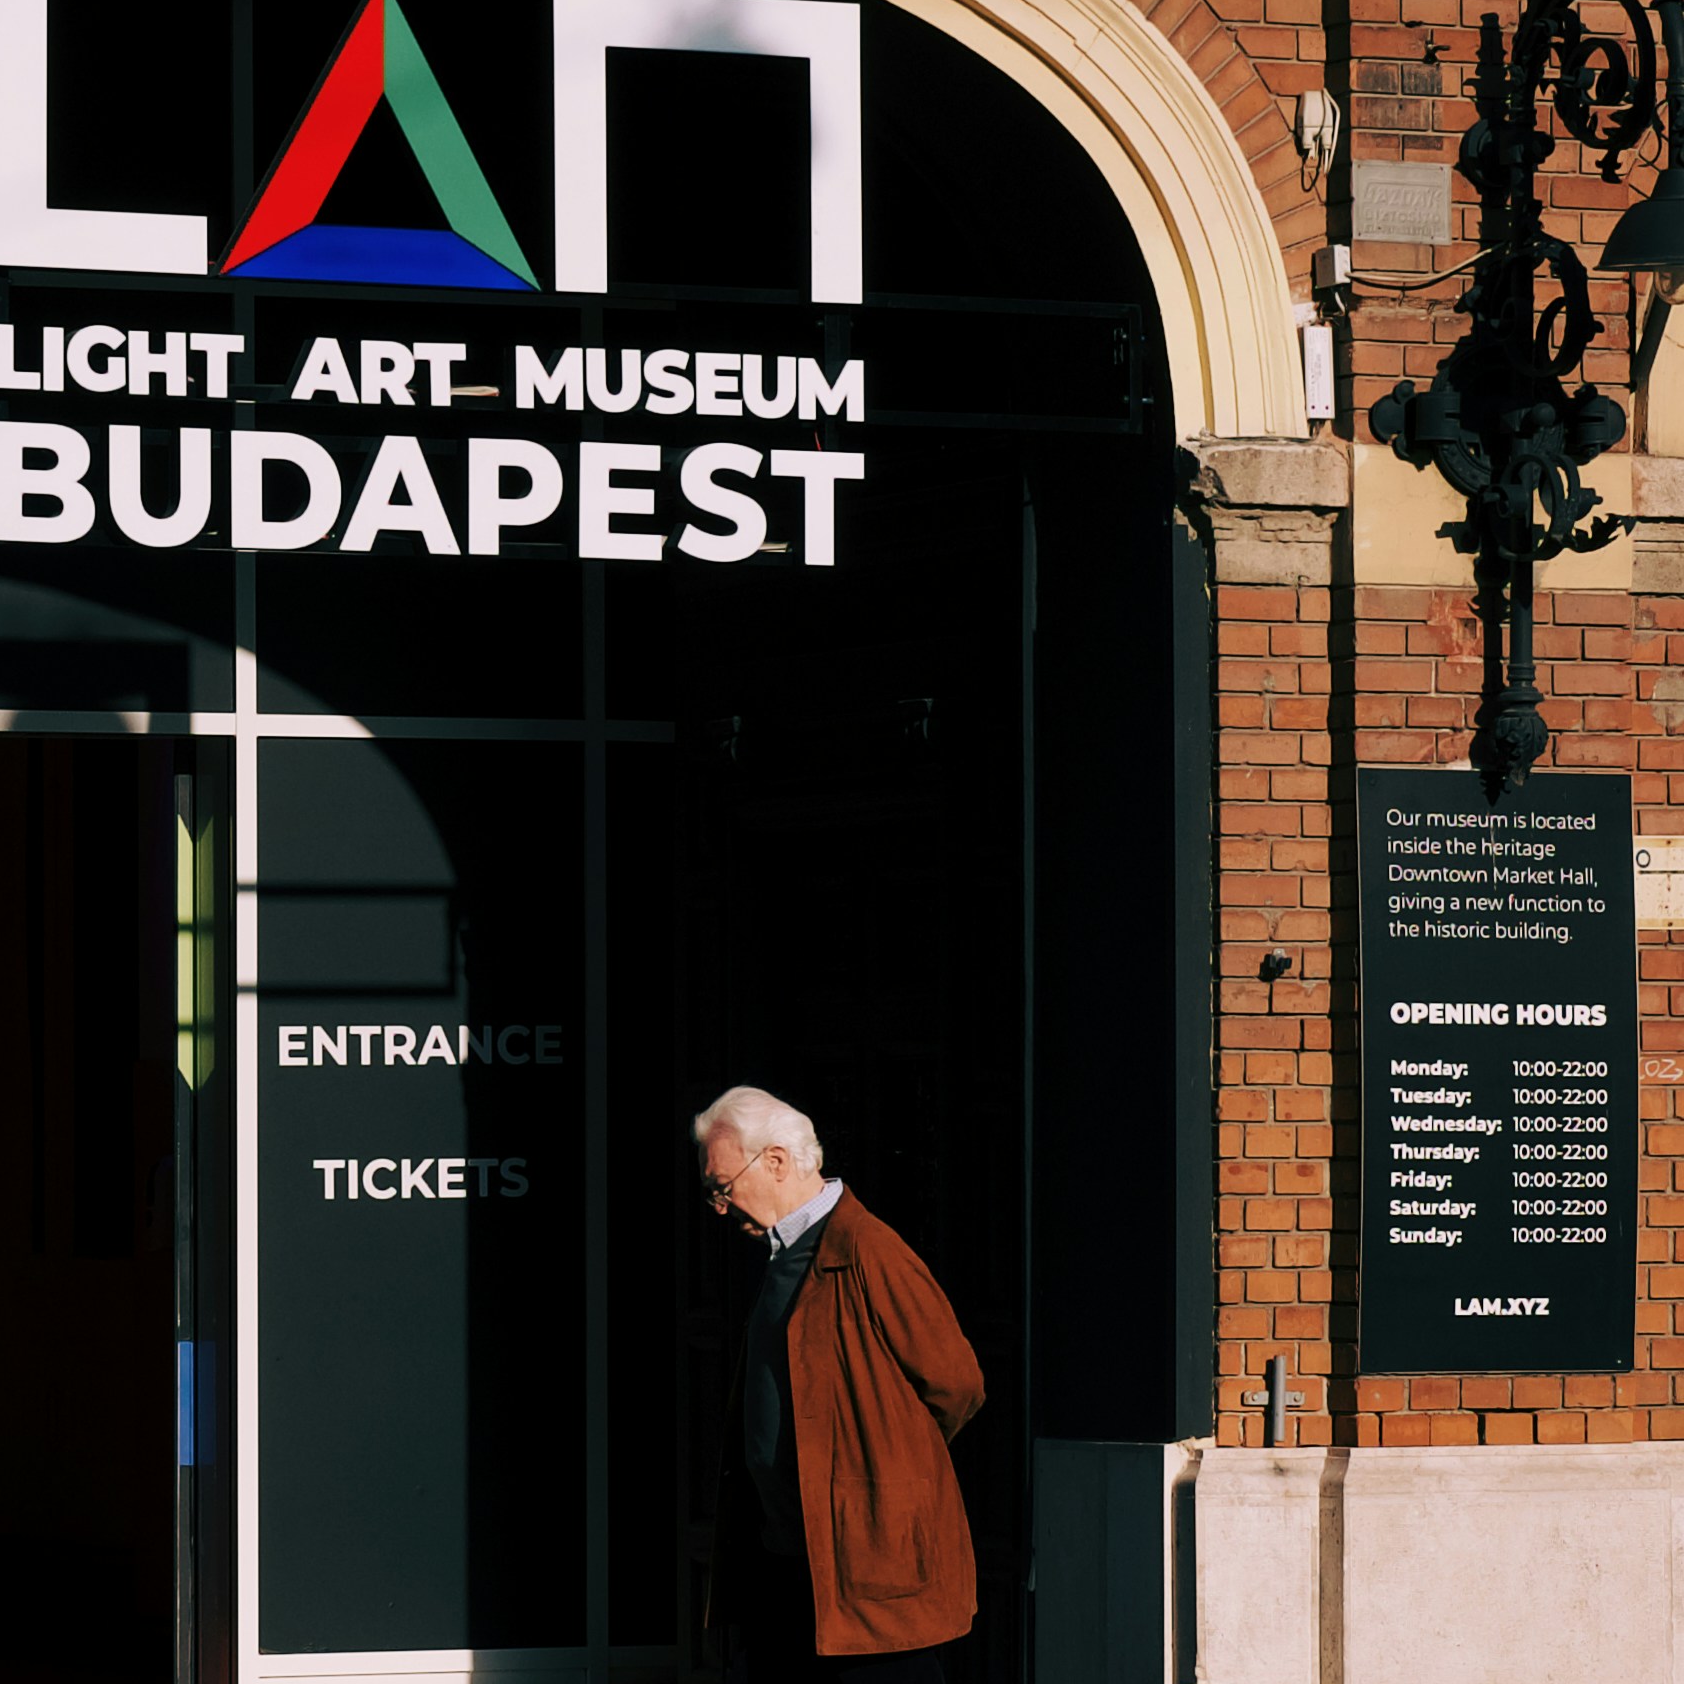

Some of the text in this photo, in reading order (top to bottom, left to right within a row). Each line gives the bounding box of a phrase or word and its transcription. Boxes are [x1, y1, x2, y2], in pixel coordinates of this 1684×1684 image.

[291, 337, 469, 406] ART
[516, 345, 864, 422] MUSEUM
[1387, 809, 1595, 830] Our museum is located
[1388, 837, 1555, 858] inside the heritage
[1389, 865, 1597, 887] Downtown Market Hall,
[1389, 893, 1605, 914] giving a new function to
[1389, 920, 1572, 943] the historic building.
[1390, 1003, 1606, 1026] OPENING HOURS
[278, 1025, 563, 1066] ENTRANCE
[1391, 1060, 1607, 1079] Monday: 10:00-22:00
[1390, 1088, 1607, 1107] Tuesday: 10:00-22:00
[1391, 1115, 1608, 1135] Wednesday: 10:00-22:00
[1390, 1143, 1607, 1163] Thursday: 10:00-22:00
[313, 1158, 529, 1199] TICKETS
[1391, 1170, 1607, 1191] Friday: 10:00-22:00
[1390, 1199, 1607, 1218] Saturday: 10:00-22:00
[1390, 1227, 1606, 1247] Sunday: 10:00-22:00
[1455, 1298, 1549, 1315] LAM.XYZ
